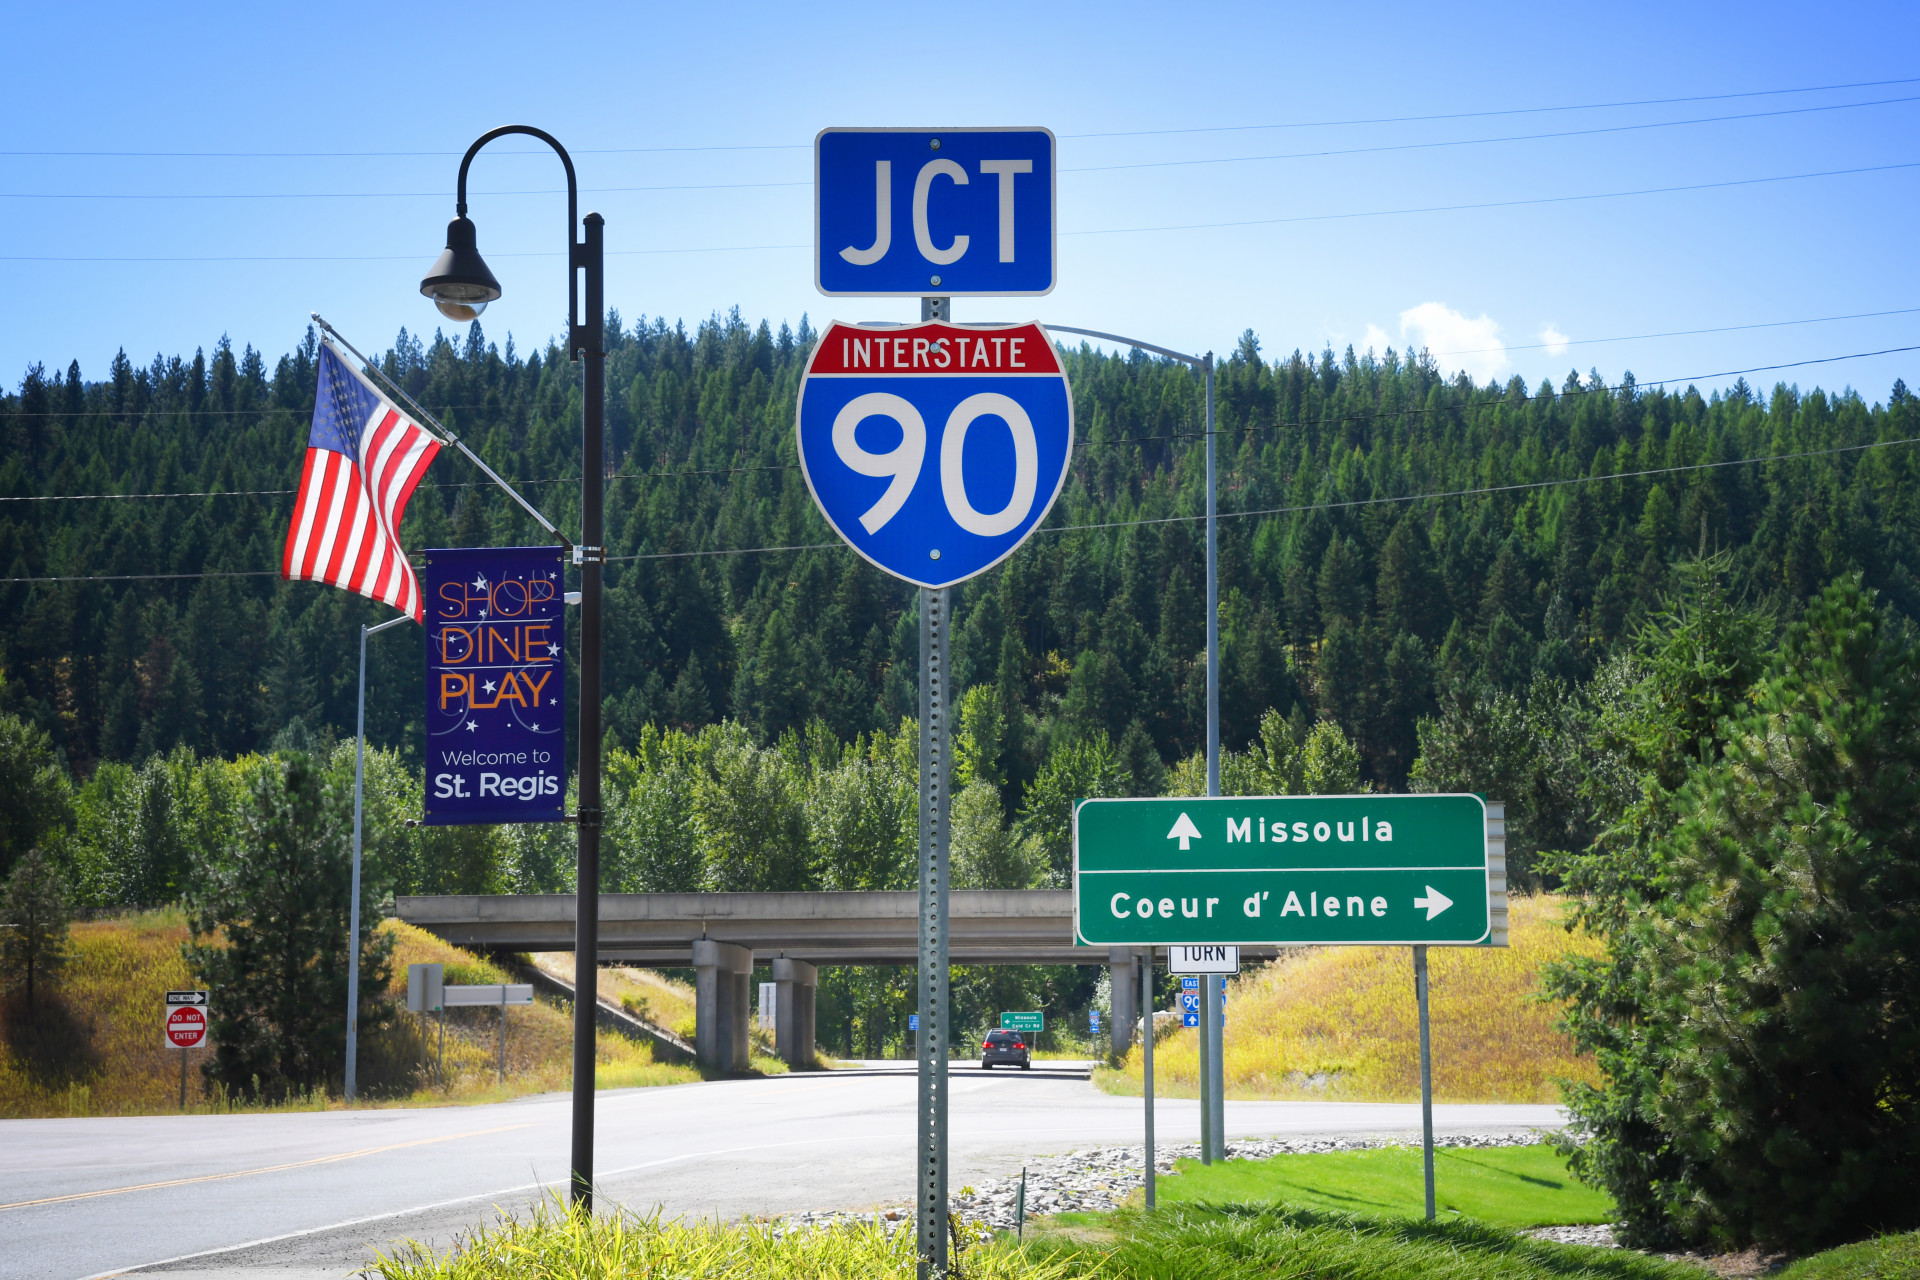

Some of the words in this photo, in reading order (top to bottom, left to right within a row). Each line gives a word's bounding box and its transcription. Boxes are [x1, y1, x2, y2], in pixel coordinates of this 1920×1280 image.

[839, 158, 1033, 266] JCT
[843, 337, 1026, 368] INTERSTATE
[831, 392, 1038, 537] 90
[438, 580, 555, 618] SHOP
[442, 625, 551, 664] DINE
[440, 670, 552, 710] PLAY
[441, 750, 527, 766] Welcome
[532, 749, 551, 764] to
[434, 773, 471, 799] St.
[479, 770, 559, 801] Regis
[1226, 816, 1393, 843] Missoula
[1110, 892, 1220, 919] Coeur
[1184, 946, 1225, 961] TURN
[174, 1032, 198, 1040] ENTER
